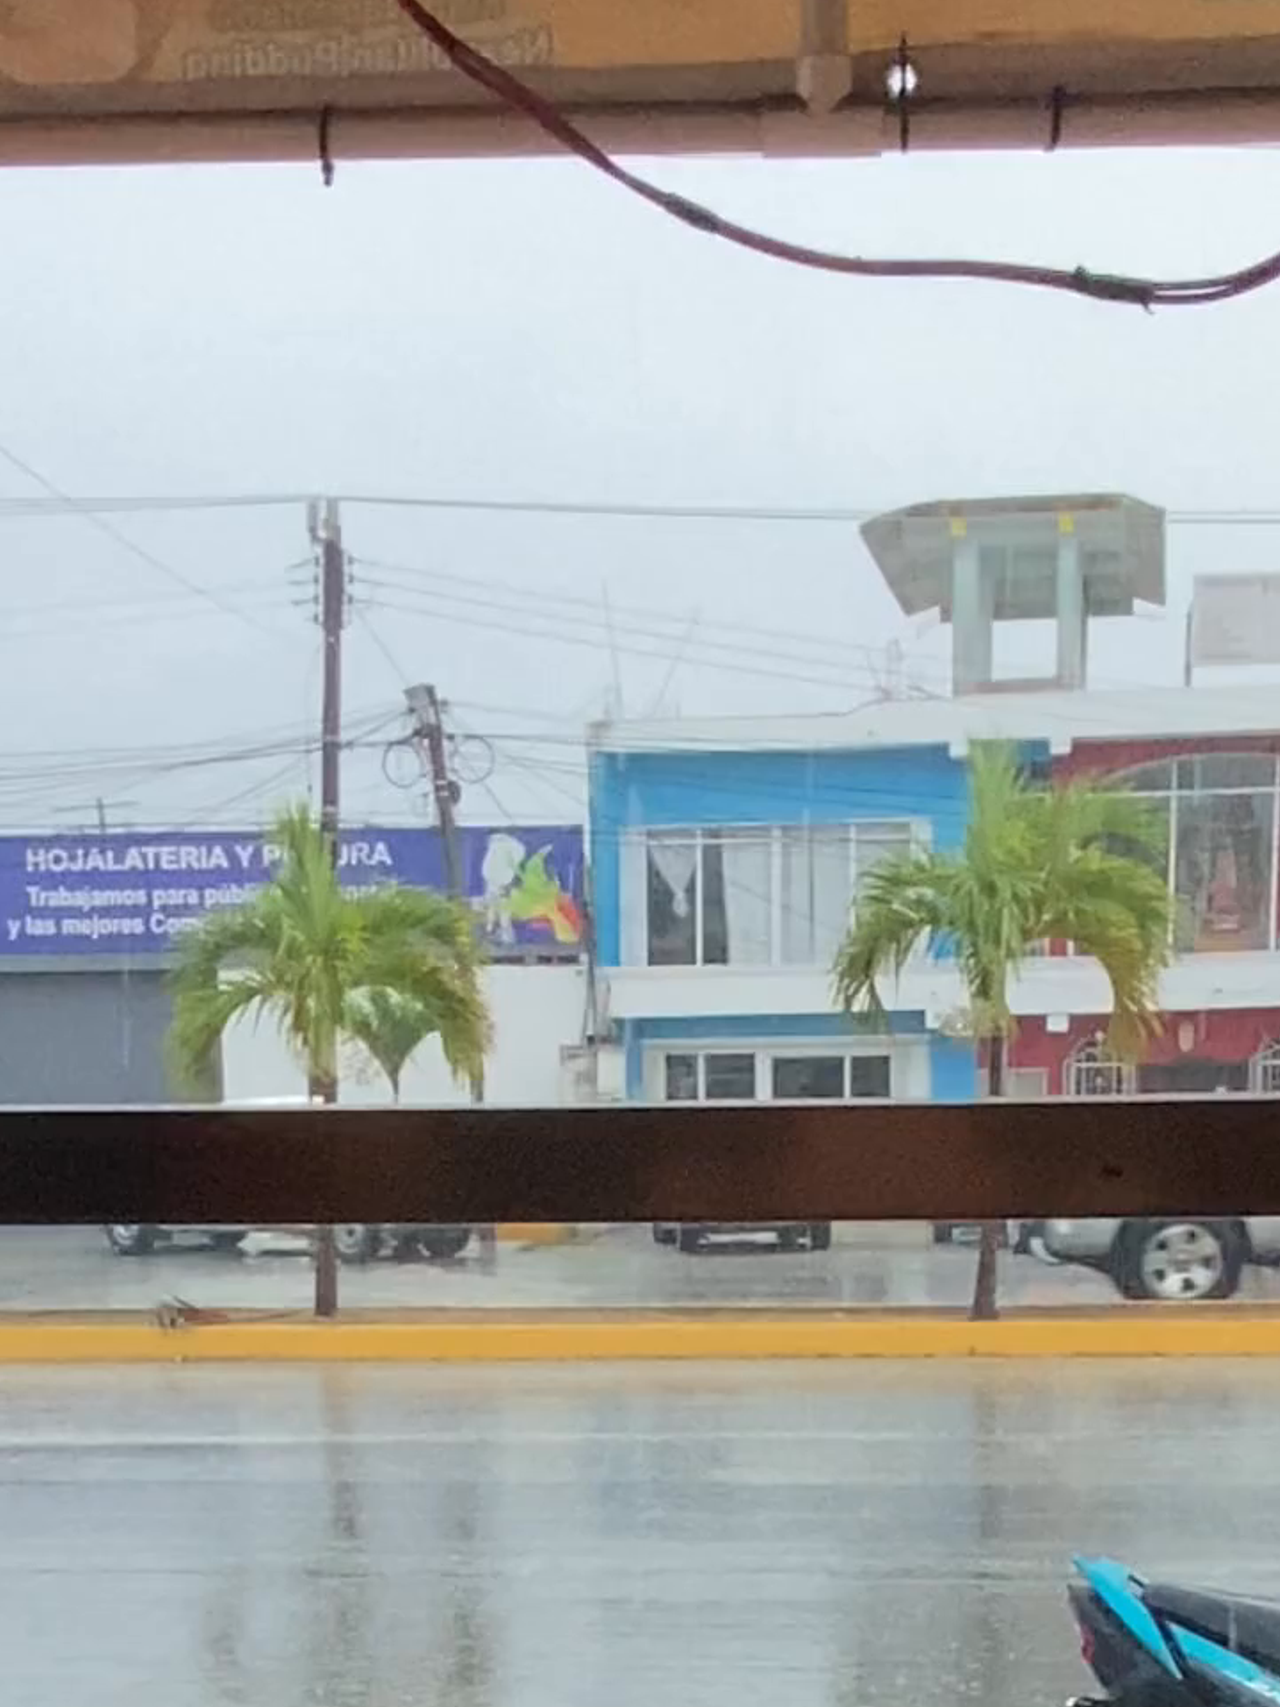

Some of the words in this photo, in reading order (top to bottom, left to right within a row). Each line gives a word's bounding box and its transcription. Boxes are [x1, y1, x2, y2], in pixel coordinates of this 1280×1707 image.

[25, 844, 230, 872] HOJALATERIA
[234, 844, 255, 868] Y
[25, 885, 148, 912] Trabajamos
[151, 888, 200, 910] para
[6, 917, 21, 941] y
[25, 914, 57, 936] las
[60, 914, 146, 940] mejores
